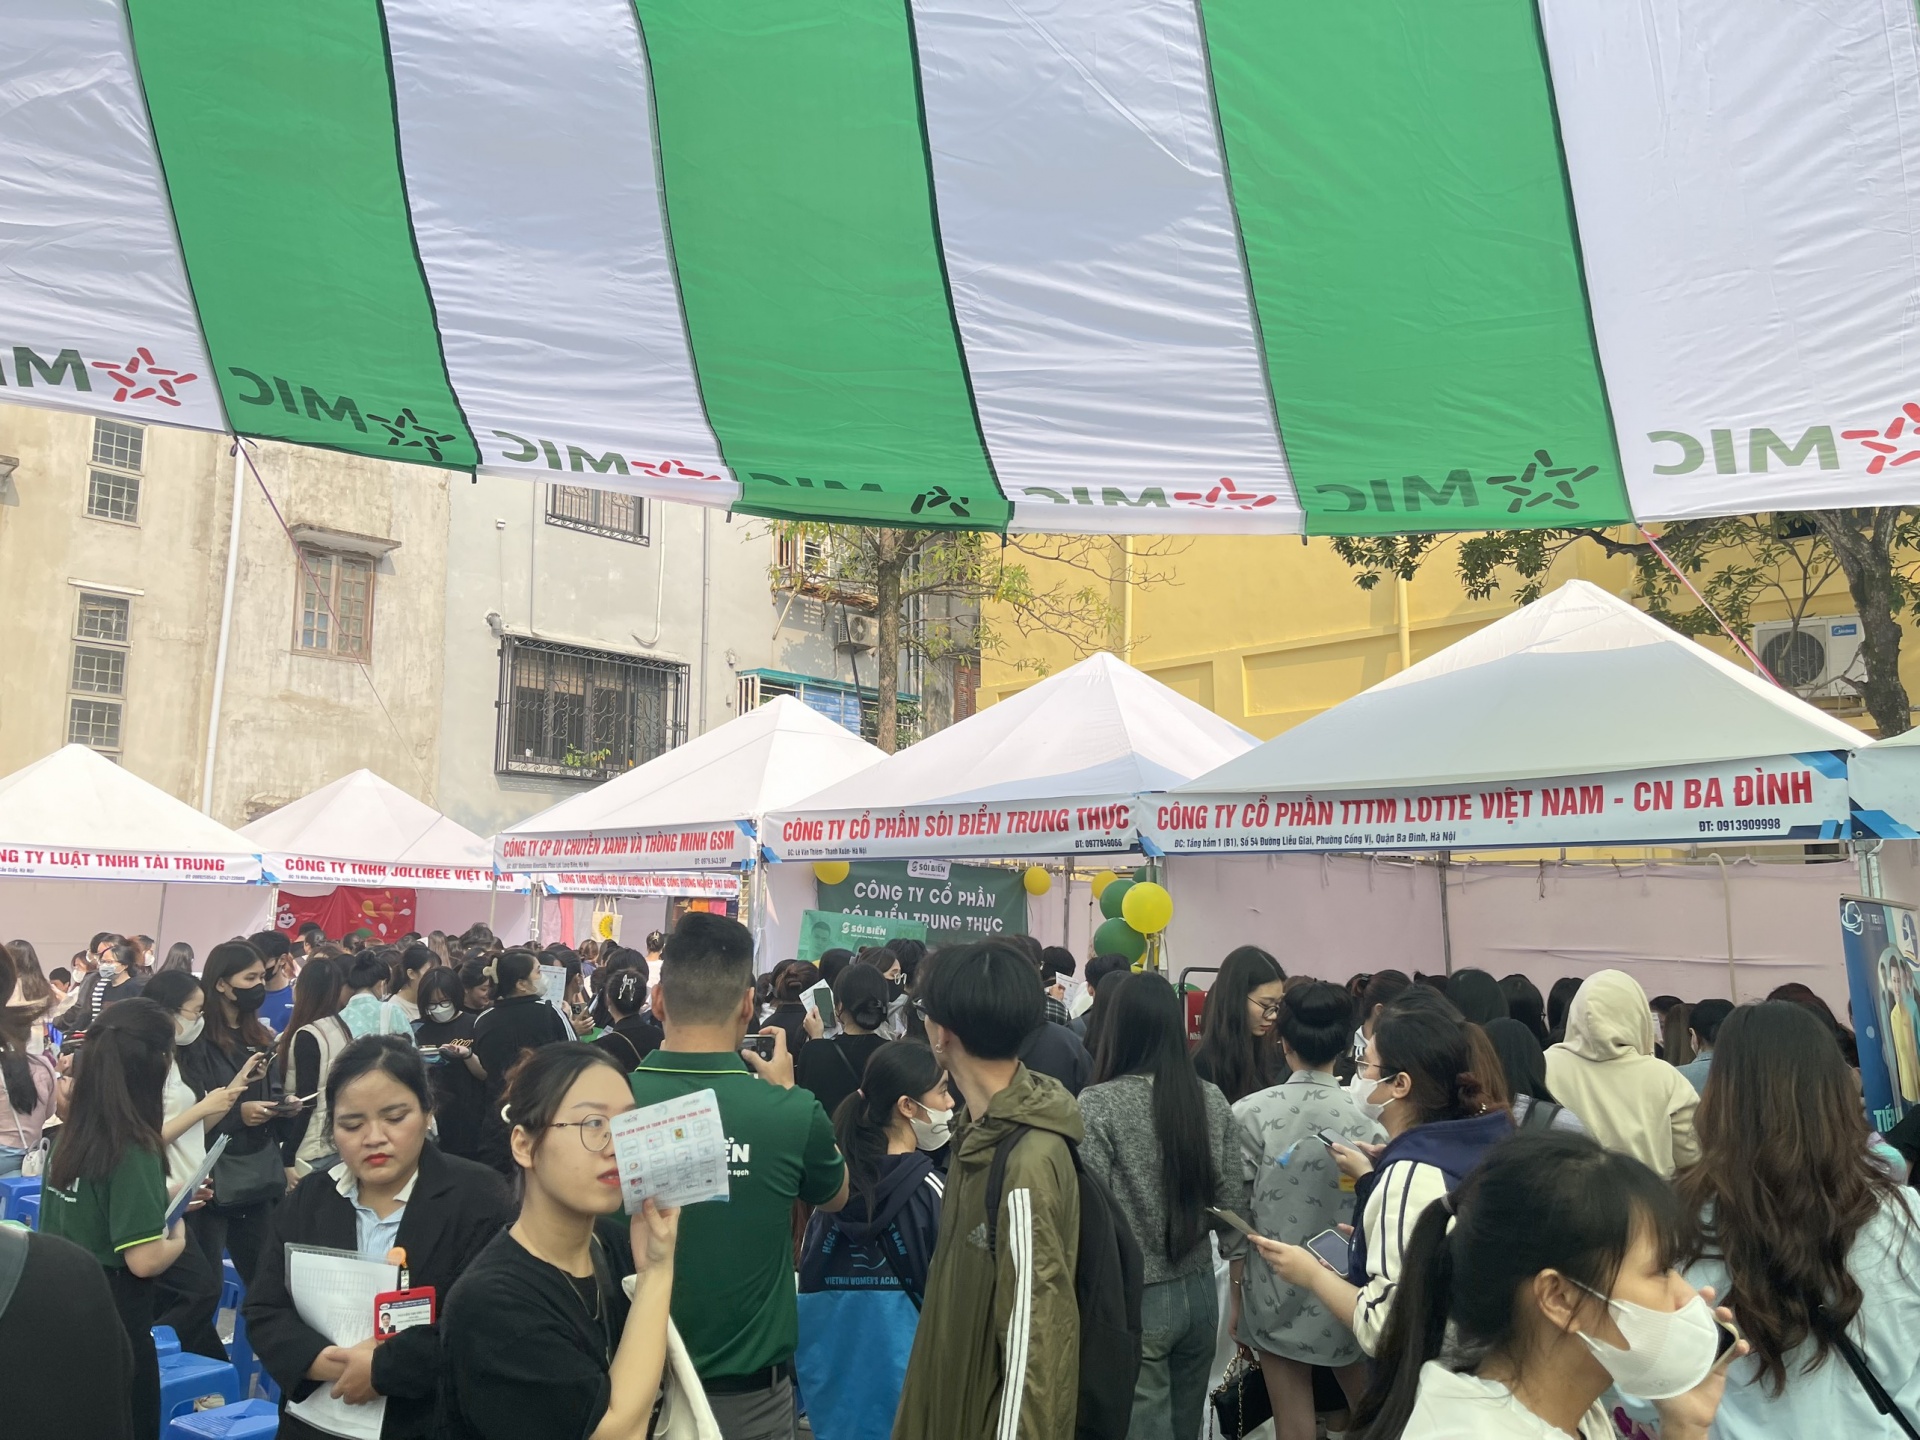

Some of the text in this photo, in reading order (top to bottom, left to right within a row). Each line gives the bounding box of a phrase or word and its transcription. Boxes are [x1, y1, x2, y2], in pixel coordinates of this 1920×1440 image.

[1156, 801, 1207, 831] CÔNG
[1213, 804, 1238, 830] TY
[1241, 795, 1269, 828] CỔ
[1274, 794, 1334, 827] PHẦN
[1339, 797, 1397, 824] TTTM
[1403, 793, 1473, 822] LOTTE
[1479, 788, 1534, 824] VIỆT
[1541, 784, 1604, 816] NAM
[1633, 780, 1674, 812] CN
[1683, 778, 1724, 809] BA
[1733, 768, 1813, 806] ĐÌNH
[782, 804, 1130, 842] CÔNG TY CỔ PHẦN SÓI BIỂN TRUNG THỰC
[1699, 818, 1781, 832] ĐT: 0913909998
[504, 830, 735, 858] CÔNG TY CP DI CHUYỂN XANH VÀ THÔNG MINH GSM
[1174, 838, 1185, 848] ĐC:
[1218, 838, 1222, 847] 1
[1224, 838, 1239, 848] (B1),
[1240, 836, 1249, 846] Số
[1250, 837, 1258, 846] 54
[1260, 836, 1282, 848] Đường
[1298, 835, 1314, 847] Giai,
[1316, 834, 1344, 846] Phường
[1376, 832, 1394, 845] Quận
[1396, 833, 1407, 843] Ba
[1408, 831, 1428, 844] Đình,
[1430, 832, 1442, 842] Hà
[1443, 831, 1456, 844] Nội
[25, 850, 44, 865] TY
[50, 850, 91, 869] LUẬT
[96, 854, 139, 869] TNHH
[144, 853, 168, 870] TÀI
[174, 857, 225, 872] TRUNG
[285, 857, 325, 874] CÔNG
[330, 861, 349, 875] TY
[350, 862, 387, 876] TNHH
[390, 865, 452, 880] JOLLIBEE
[454, 868, 481, 884] VIỆT
[854, 880, 996, 908] CÔNG TY CỔ PHẦN
[914, 914, 962, 930] TRUNG
[966, 916, 1003, 936] THỰC
